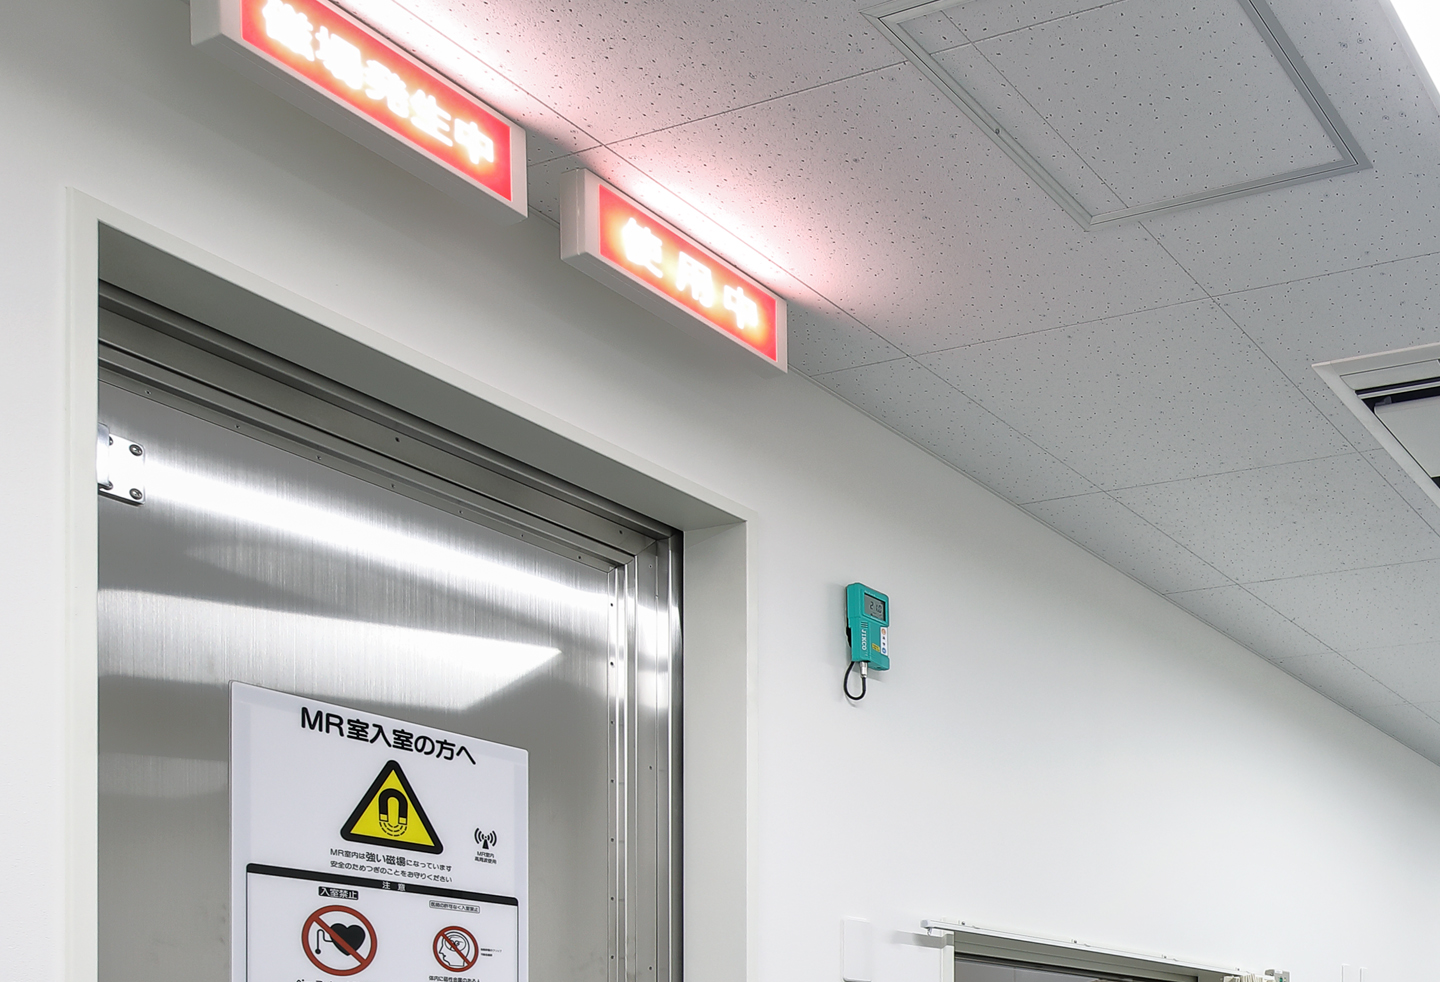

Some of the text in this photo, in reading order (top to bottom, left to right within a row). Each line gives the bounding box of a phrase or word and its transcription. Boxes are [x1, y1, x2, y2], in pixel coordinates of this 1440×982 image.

[300, 706, 477, 766] MR室入室の方へ
[329, 848, 453, 873] MR室内は強い磁場になっています
[319, 887, 358, 900] 入室禁止
